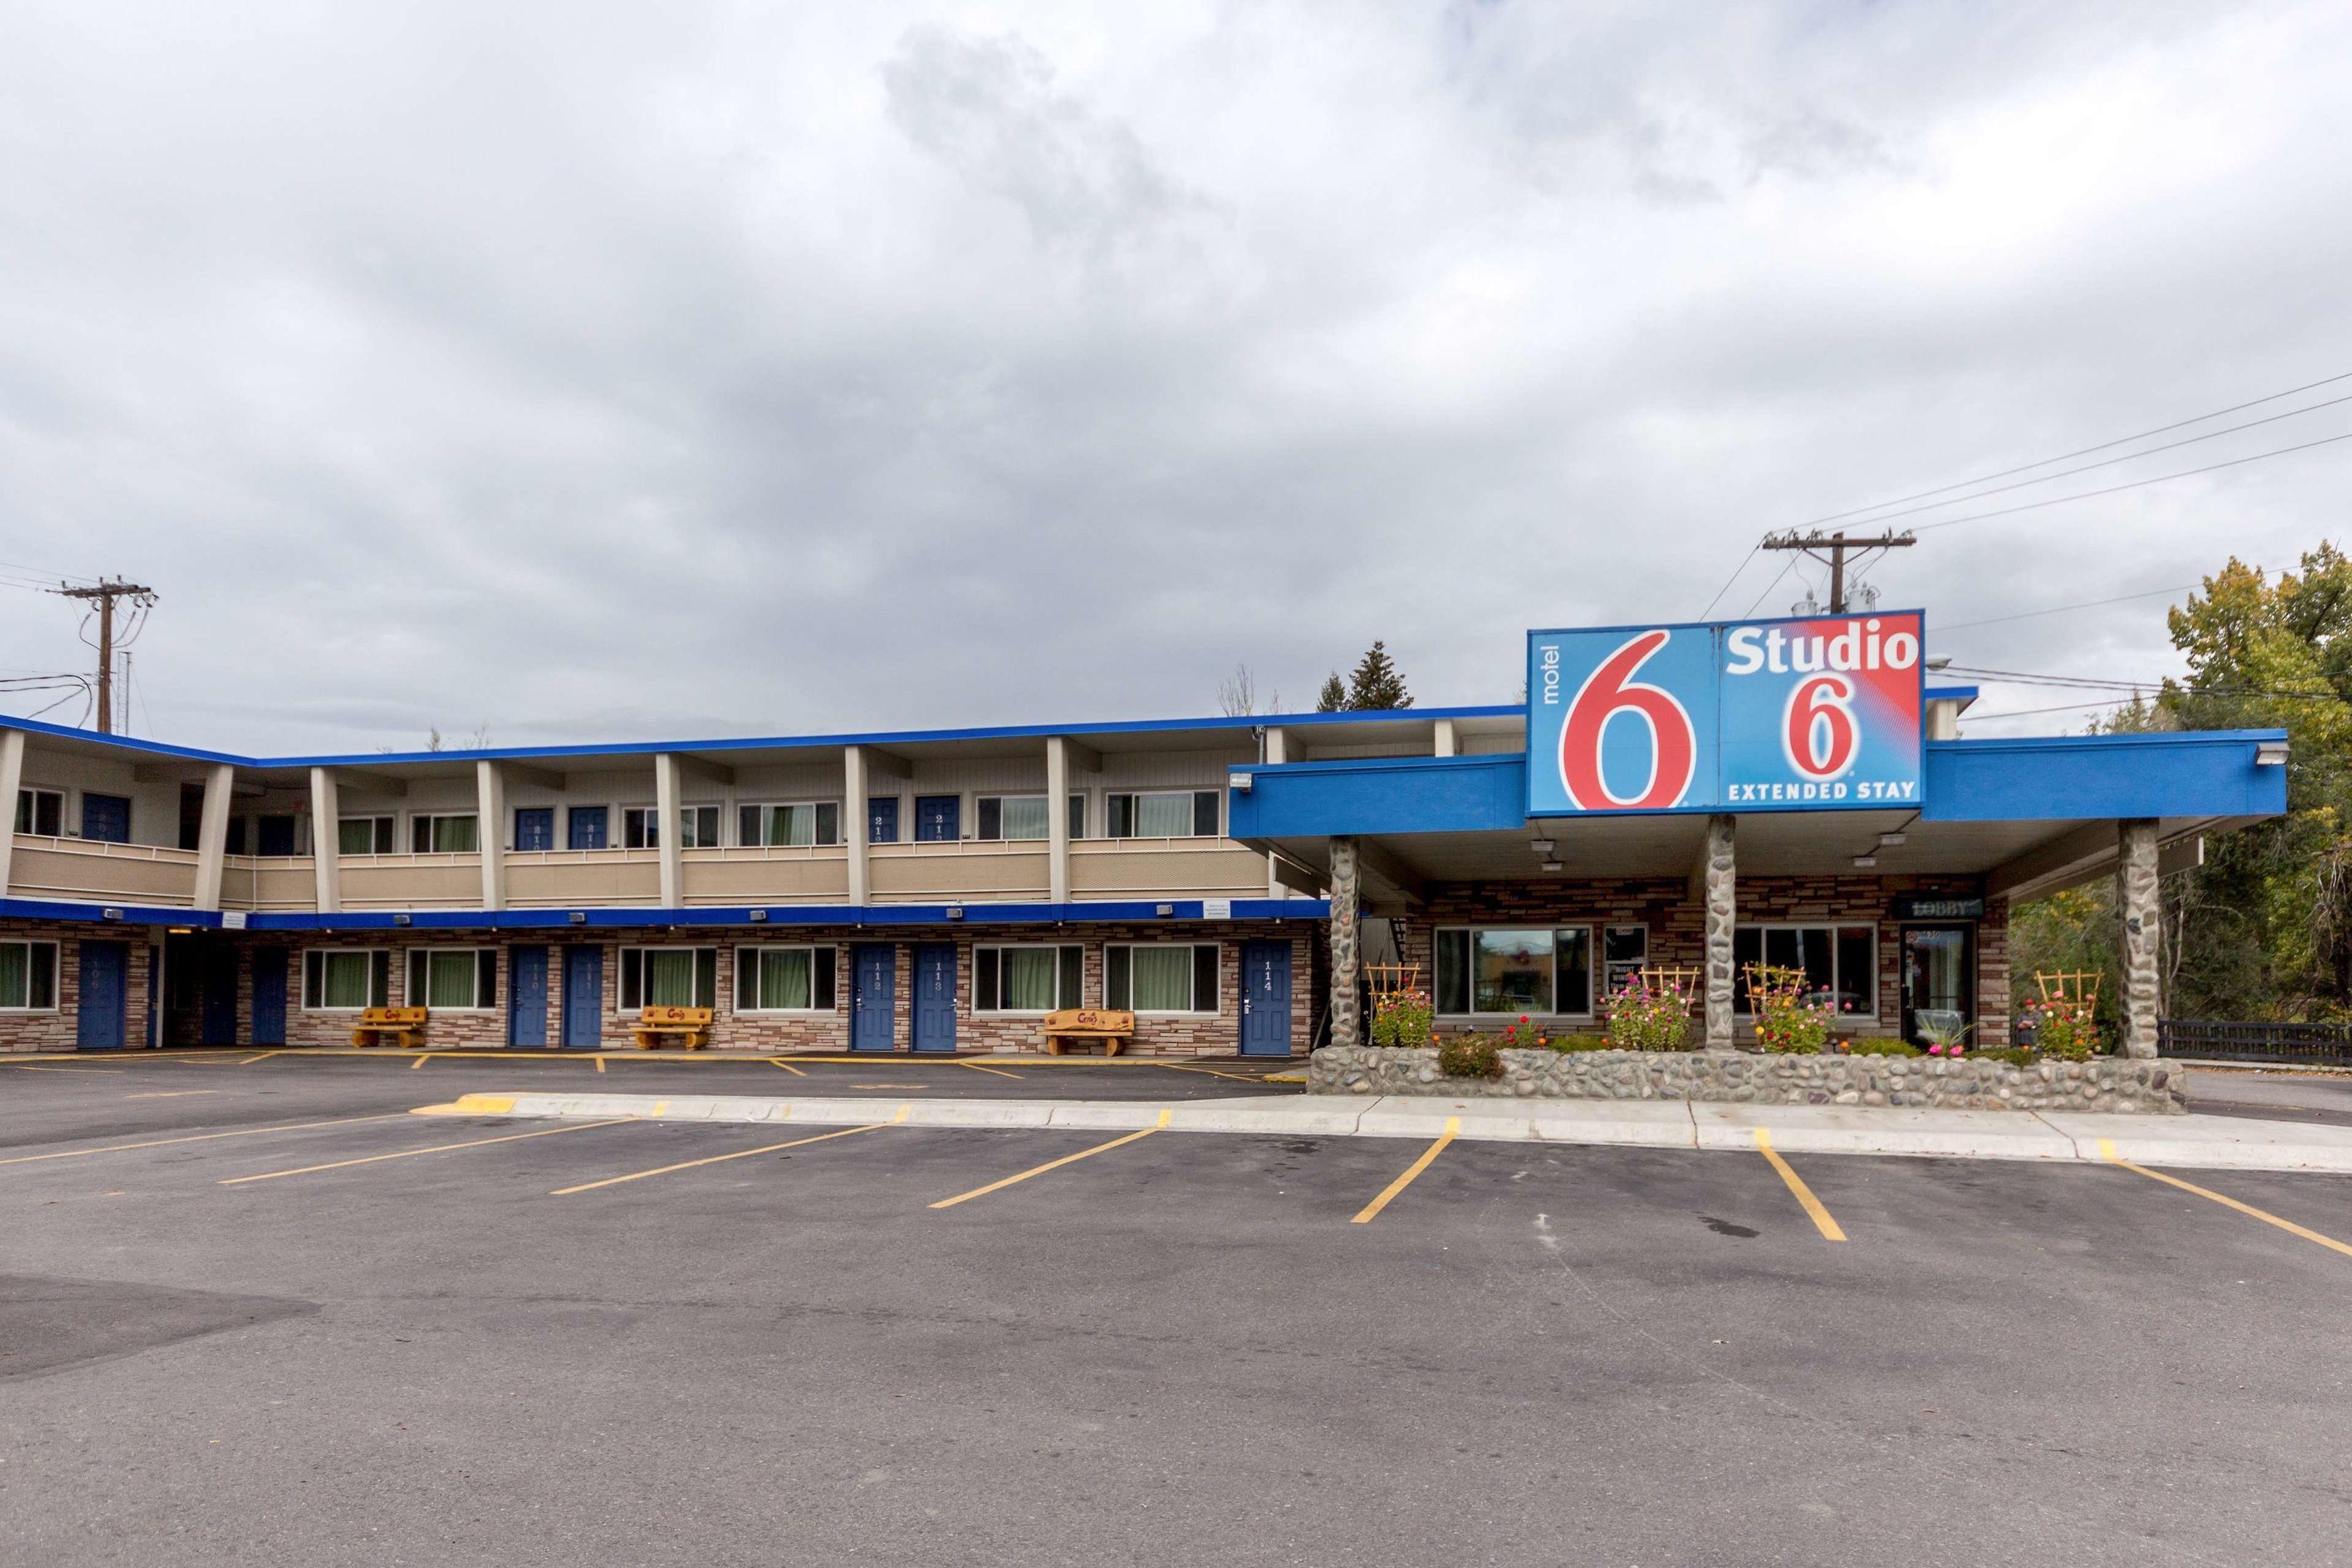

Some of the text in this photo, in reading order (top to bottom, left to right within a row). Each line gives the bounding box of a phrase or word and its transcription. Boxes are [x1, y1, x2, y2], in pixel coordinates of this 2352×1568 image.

[1540, 645, 1559, 704] motel
[1726, 618, 1919, 675] Studio
[1559, 629, 1696, 809] 6
[1786, 674, 1856, 778] 6
[1728, 782, 1915, 800] EXTENDED STAY
[1912, 900, 1968, 916] LOBBY
